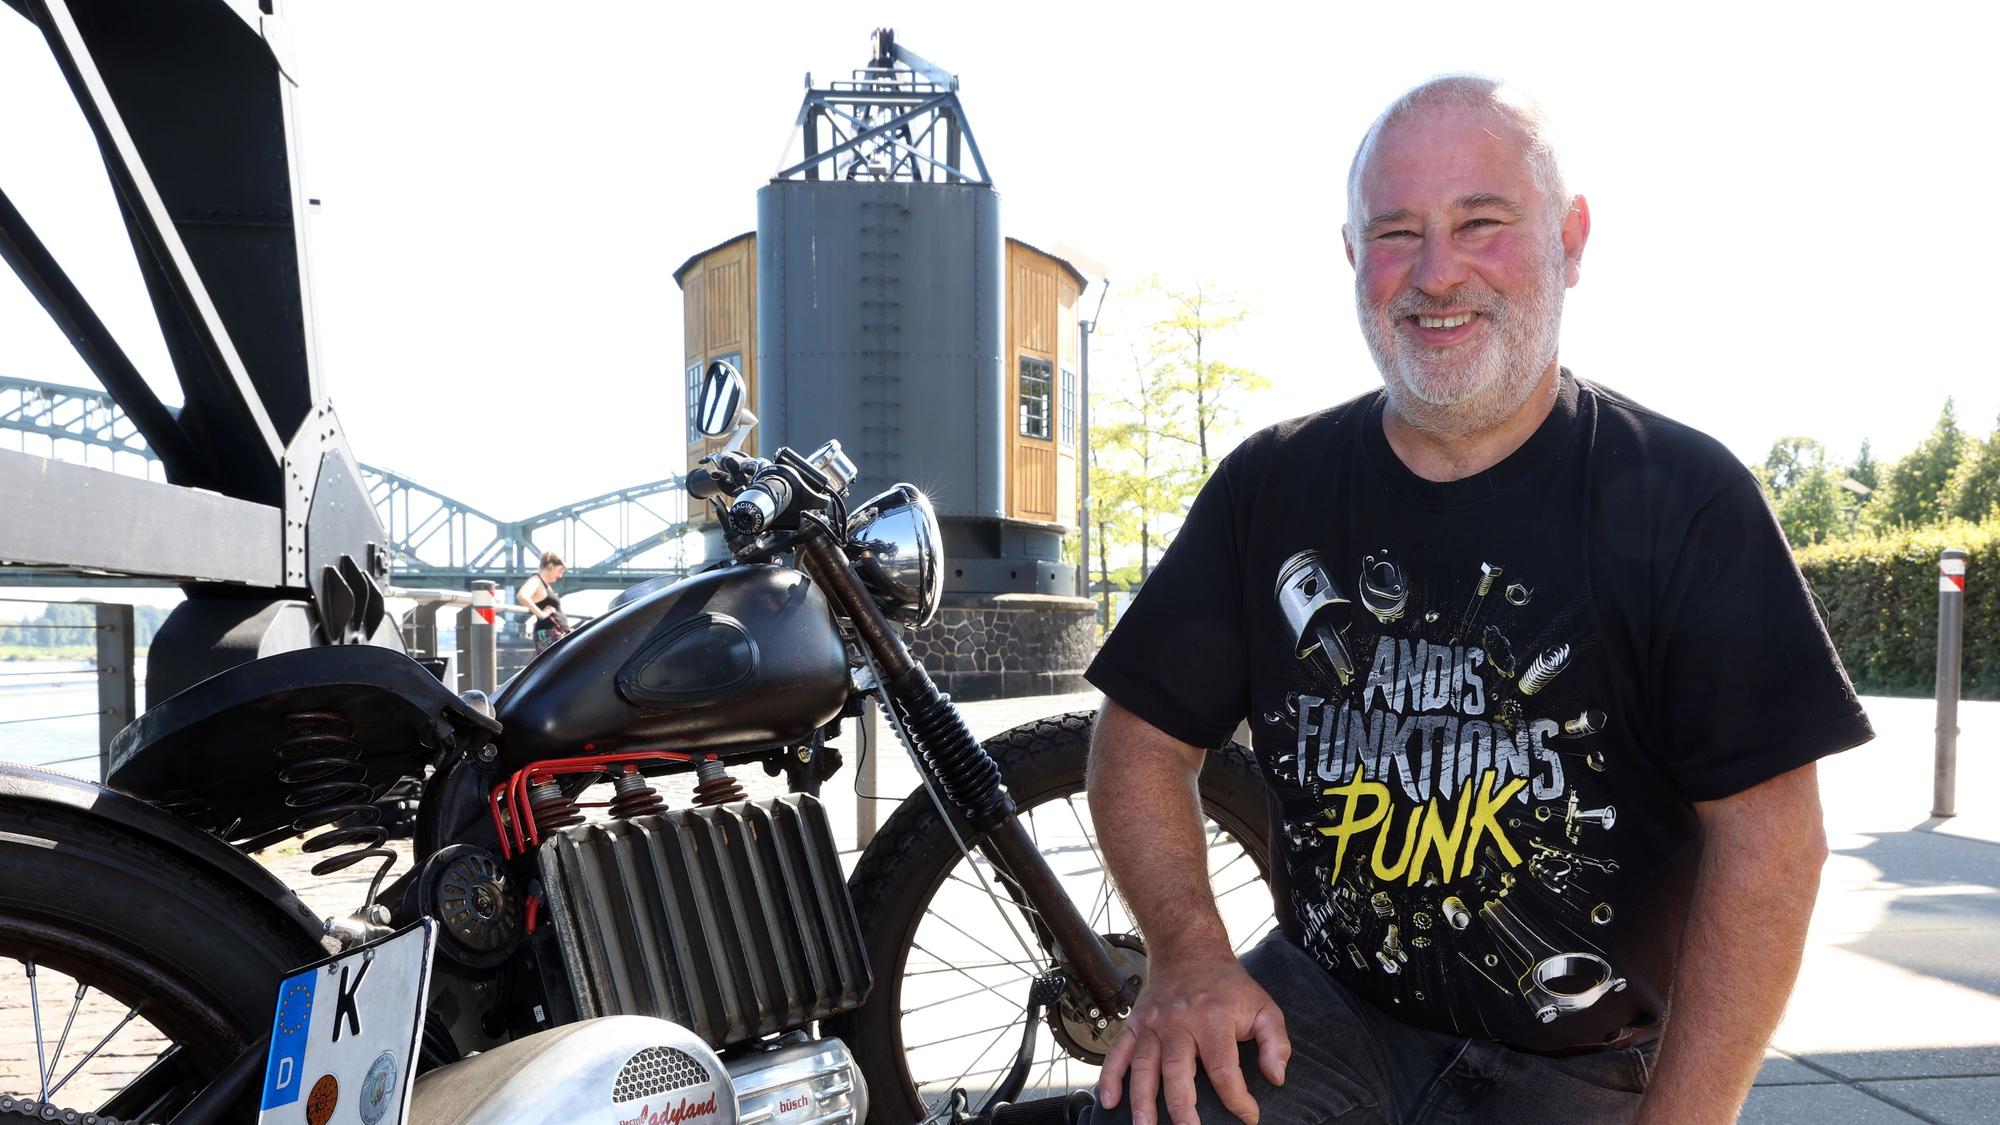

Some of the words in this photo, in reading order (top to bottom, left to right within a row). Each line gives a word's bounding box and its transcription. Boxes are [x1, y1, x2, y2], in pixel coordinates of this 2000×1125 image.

[732, 502, 757, 514] RACING
[1363, 636, 1485, 715] ANDIS
[1298, 695, 1565, 804] FUNKTIONS
[1318, 764, 1528, 887] PUNK
[332, 960, 373, 1043] K
[276, 1056, 294, 1090] D
[779, 1095, 808, 1114] büsch
